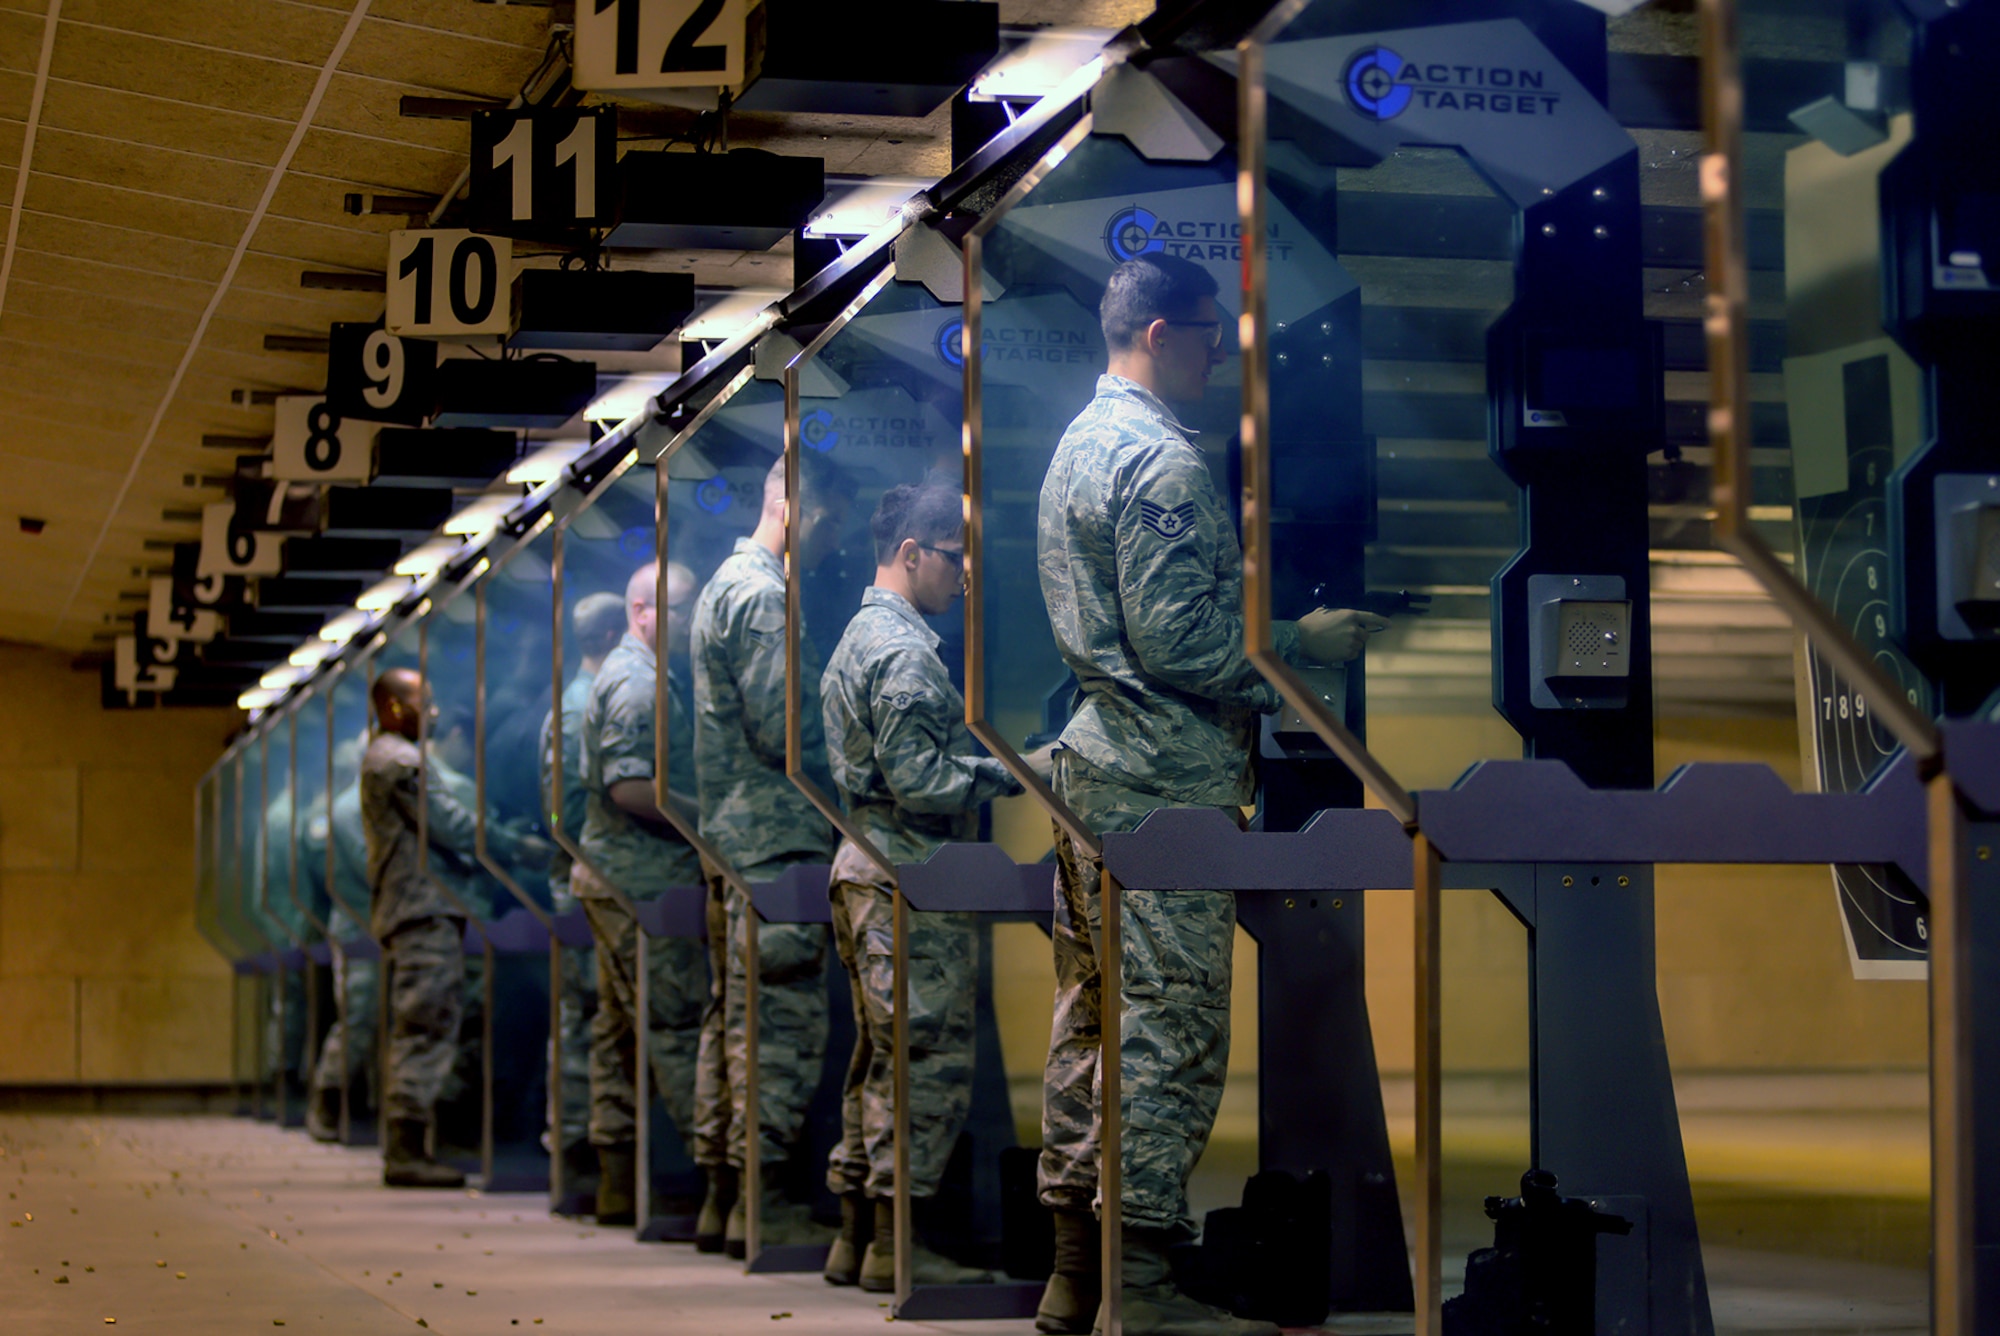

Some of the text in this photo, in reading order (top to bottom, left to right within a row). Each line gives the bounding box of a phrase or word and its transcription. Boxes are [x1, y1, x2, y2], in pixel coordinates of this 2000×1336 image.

[595, 0, 728, 75] 12
[1400, 62, 1544, 89] ACTION
[1416, 89, 1560, 115] TARGET
[492, 116, 596, 221] 11
[399, 236, 498, 325] 10
[982, 327, 1086, 345] ACTION
[992, 347, 1099, 364] TARGET
[362, 329, 405, 409] 9
[304, 402, 342, 472] 8
[1866, 565, 1878, 590] 8
[1875, 613, 1886, 638] 9
[1916, 917, 1927, 940] 6
